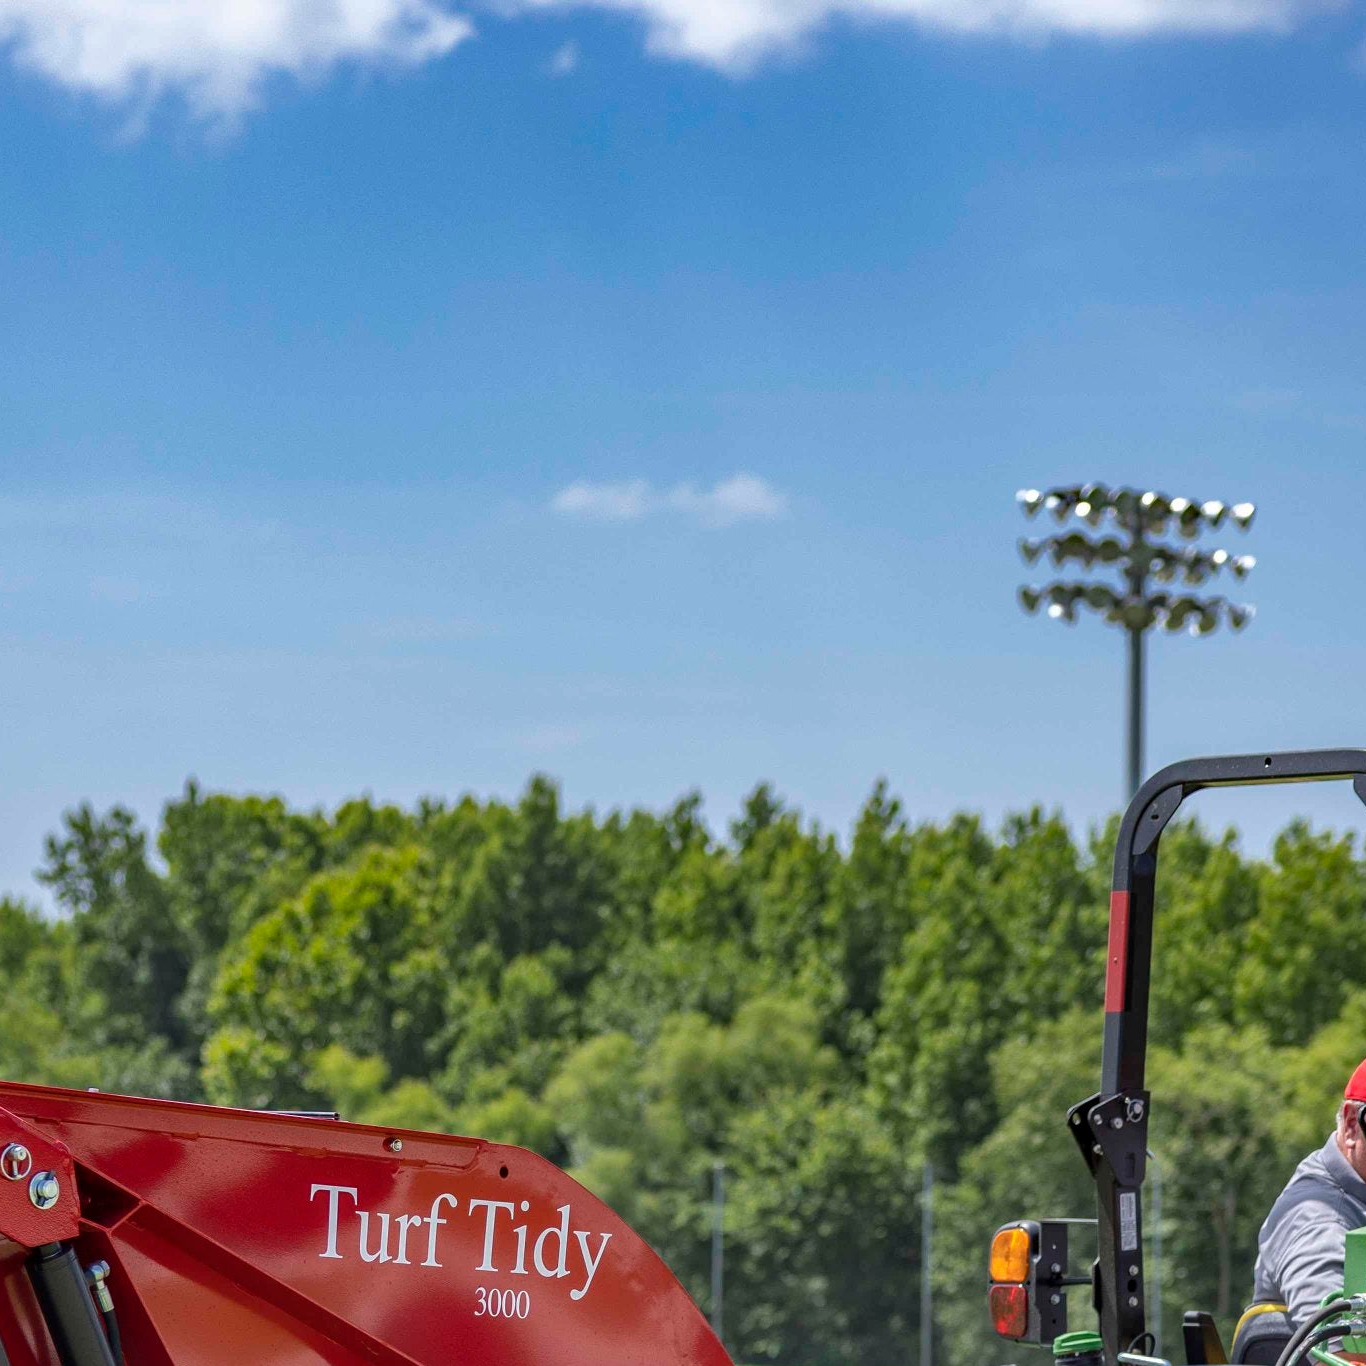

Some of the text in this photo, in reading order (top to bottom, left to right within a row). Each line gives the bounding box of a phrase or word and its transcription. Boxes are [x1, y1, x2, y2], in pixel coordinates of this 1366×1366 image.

[310, 1183, 613, 1301] Turf Tidy
[473, 1286, 530, 1319] 3000
